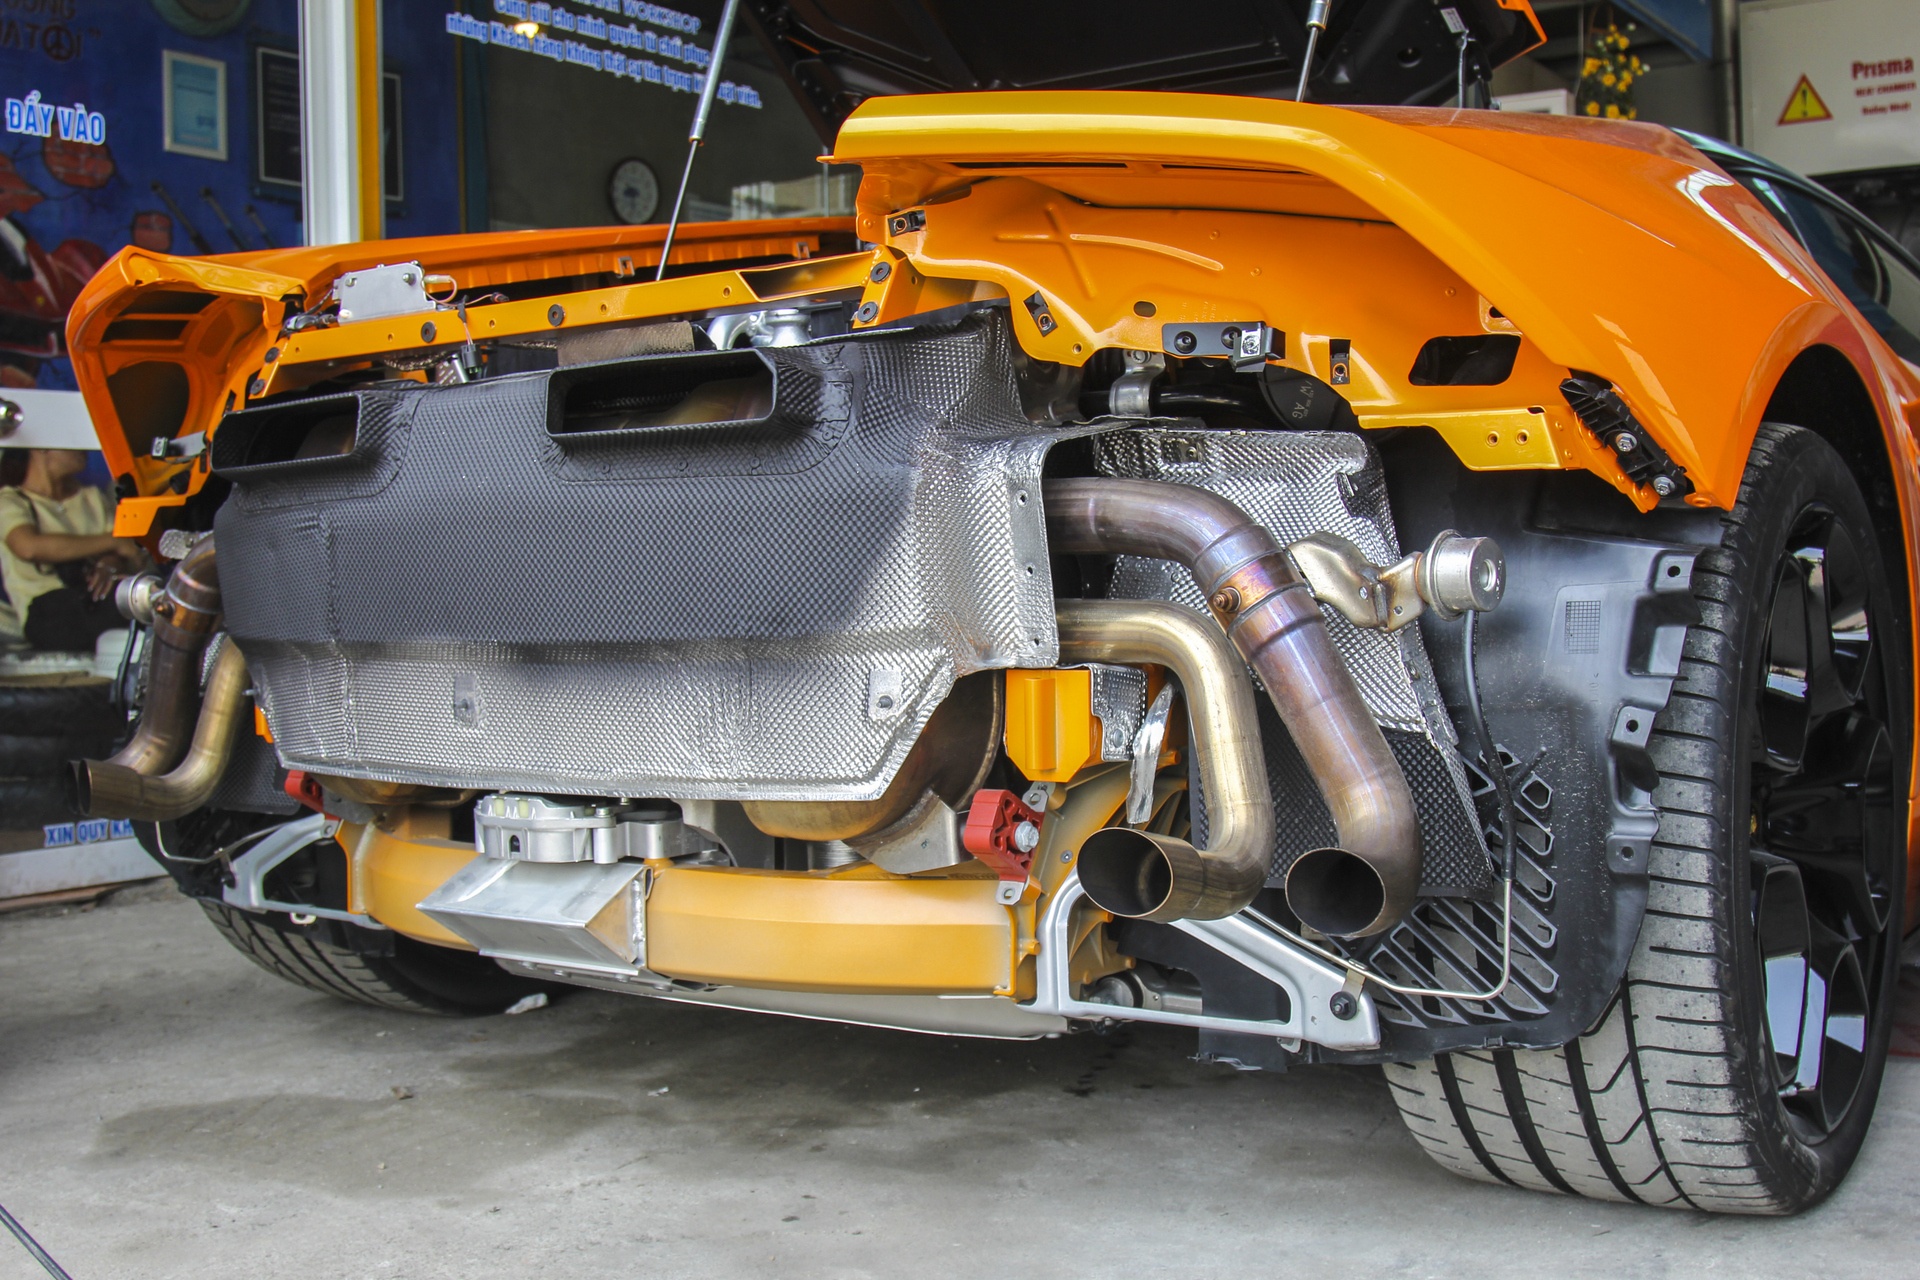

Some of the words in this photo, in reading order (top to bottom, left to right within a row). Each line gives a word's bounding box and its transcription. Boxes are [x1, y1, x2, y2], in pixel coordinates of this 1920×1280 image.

[623, 0, 701, 35] WORKSHOP
[1852, 57, 1914, 80] Prisma
[5, 89, 55, 138] ĐẨY
[56, 102, 106, 146] VÀO
[43, 821, 76, 848] XIN
